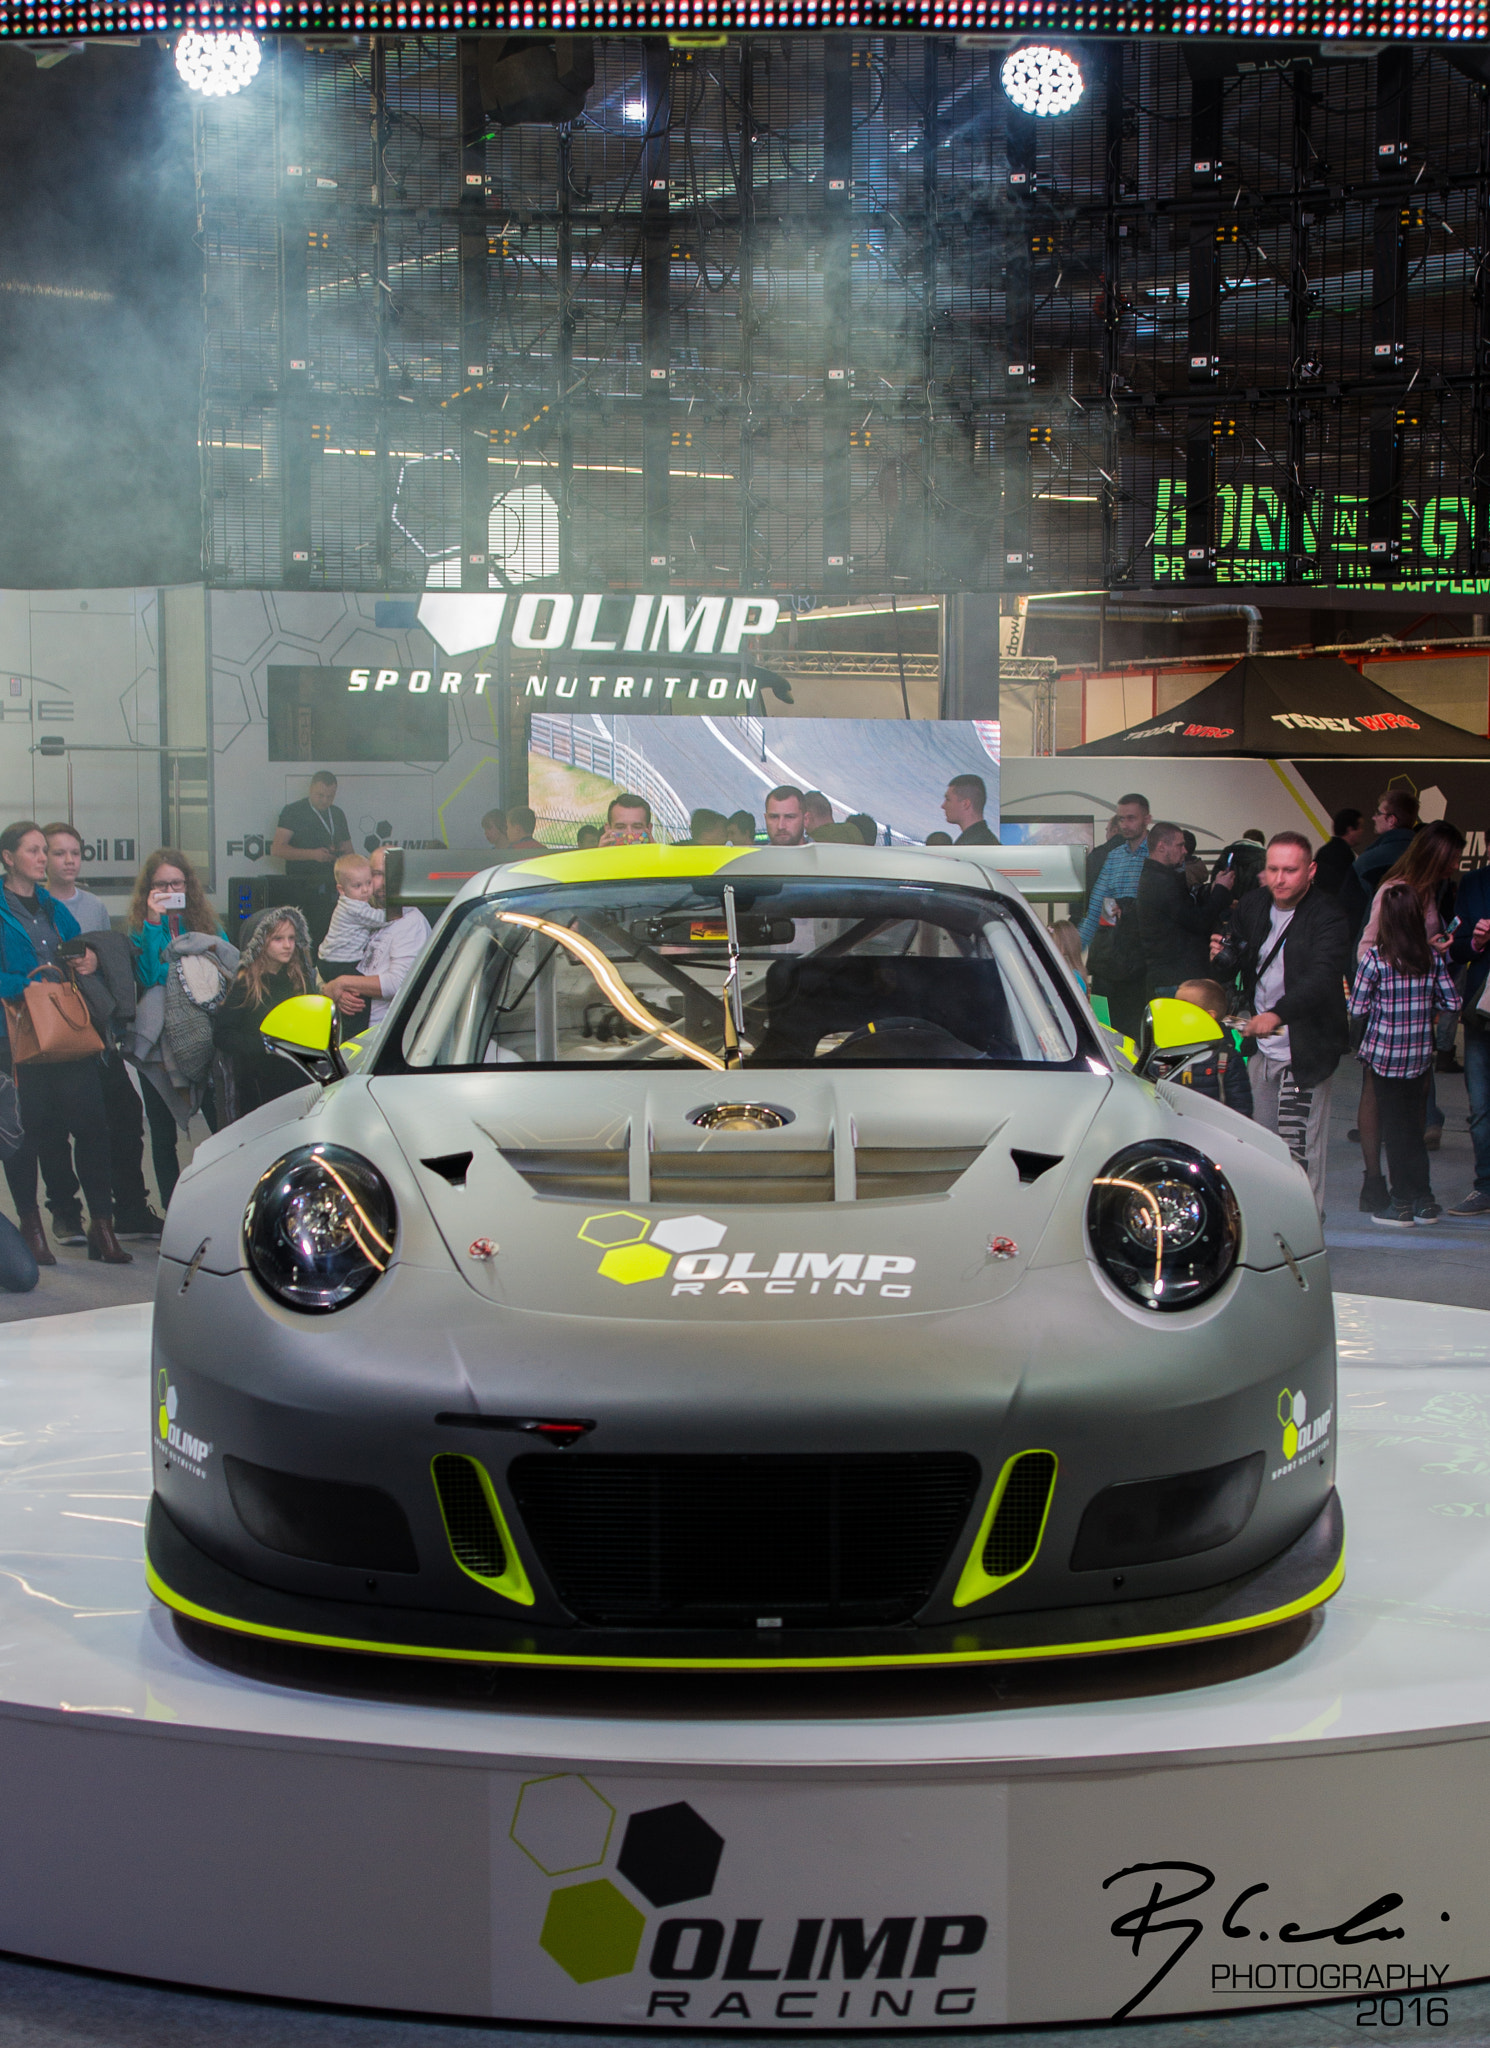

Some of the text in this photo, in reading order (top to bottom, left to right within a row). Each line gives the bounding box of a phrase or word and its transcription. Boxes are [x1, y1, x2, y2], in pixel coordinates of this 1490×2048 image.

[511, 593, 779, 654] OLIMP
[347, 669, 757, 700] SPORT NUTRITION
[1183, 724, 1234, 739] WRC
[1271, 712, 1421, 732] TEDEX WRC
[672, 1252, 916, 1281] OLIMP
[671, 1280, 912, 1298] RACING
[168, 1422, 209, 1463] OLIMP
[1297, 1408, 1332, 1452] OLIMP
[649, 1914, 988, 1981] OLIMP
[646, 1988, 977, 2019] RACING
